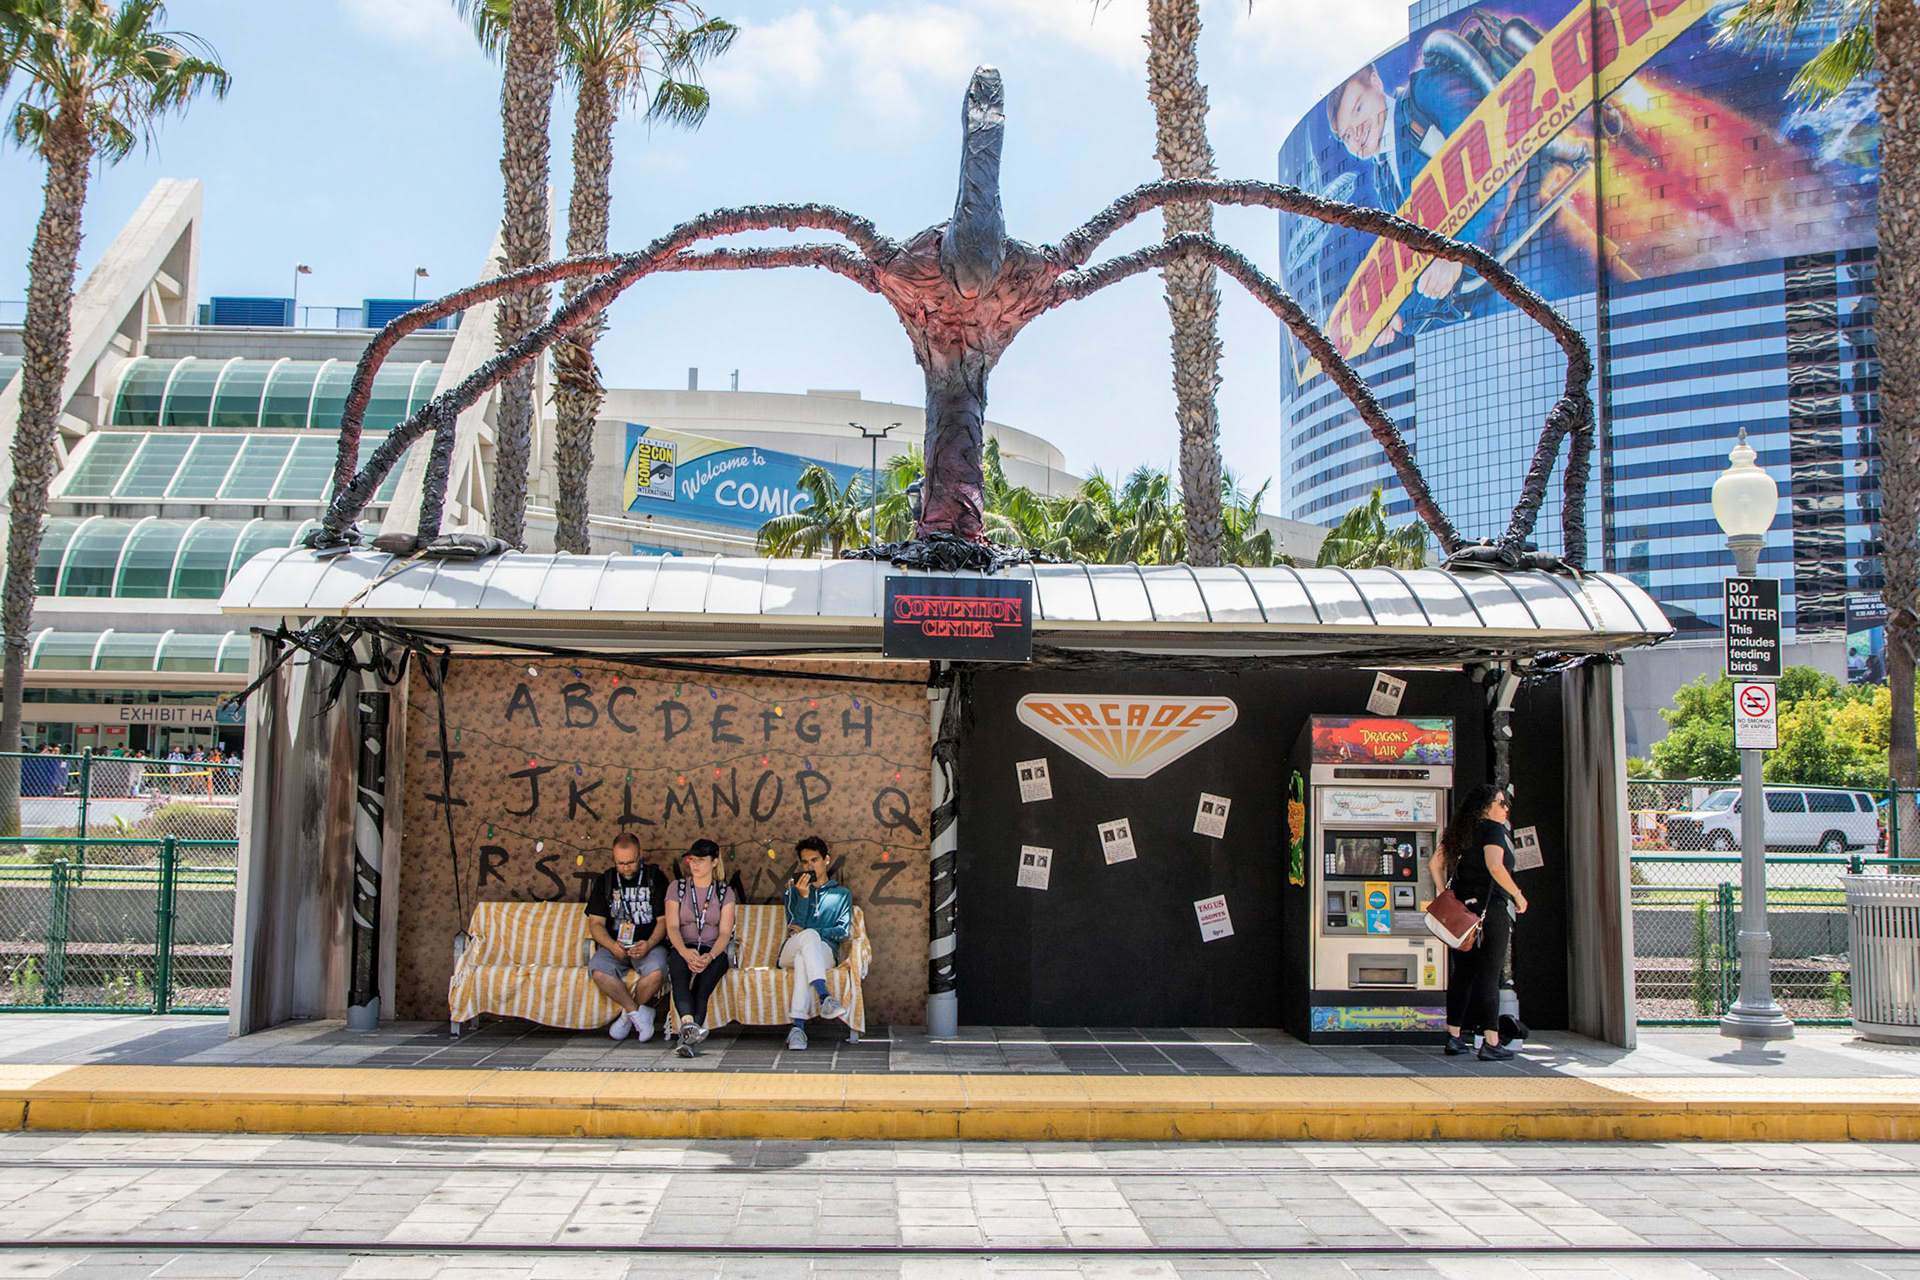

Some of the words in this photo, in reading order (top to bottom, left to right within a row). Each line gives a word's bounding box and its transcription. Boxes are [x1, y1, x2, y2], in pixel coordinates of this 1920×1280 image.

[651, 446, 674, 463] CON
[638, 444, 651, 487] COMIC
[681, 455, 750, 500] Welcome
[752, 448, 766, 466] to
[1728, 582, 1749, 594] DO
[1729, 595, 1759, 607] NOT
[1730, 608, 1777, 620] LITTER
[922, 620, 994, 638] CENTER
[1729, 624, 1753, 634] This
[1730, 636, 1776, 646] includes
[1730, 648, 1771, 662] feeding
[1730, 661, 1758, 672] birds
[120, 708, 186, 721] EXHIBIT
[1024, 702, 1230, 728] ARCADE
[1360, 729, 1408, 746] DRAGON'S
[1374, 745, 1400, 758] LAIR
